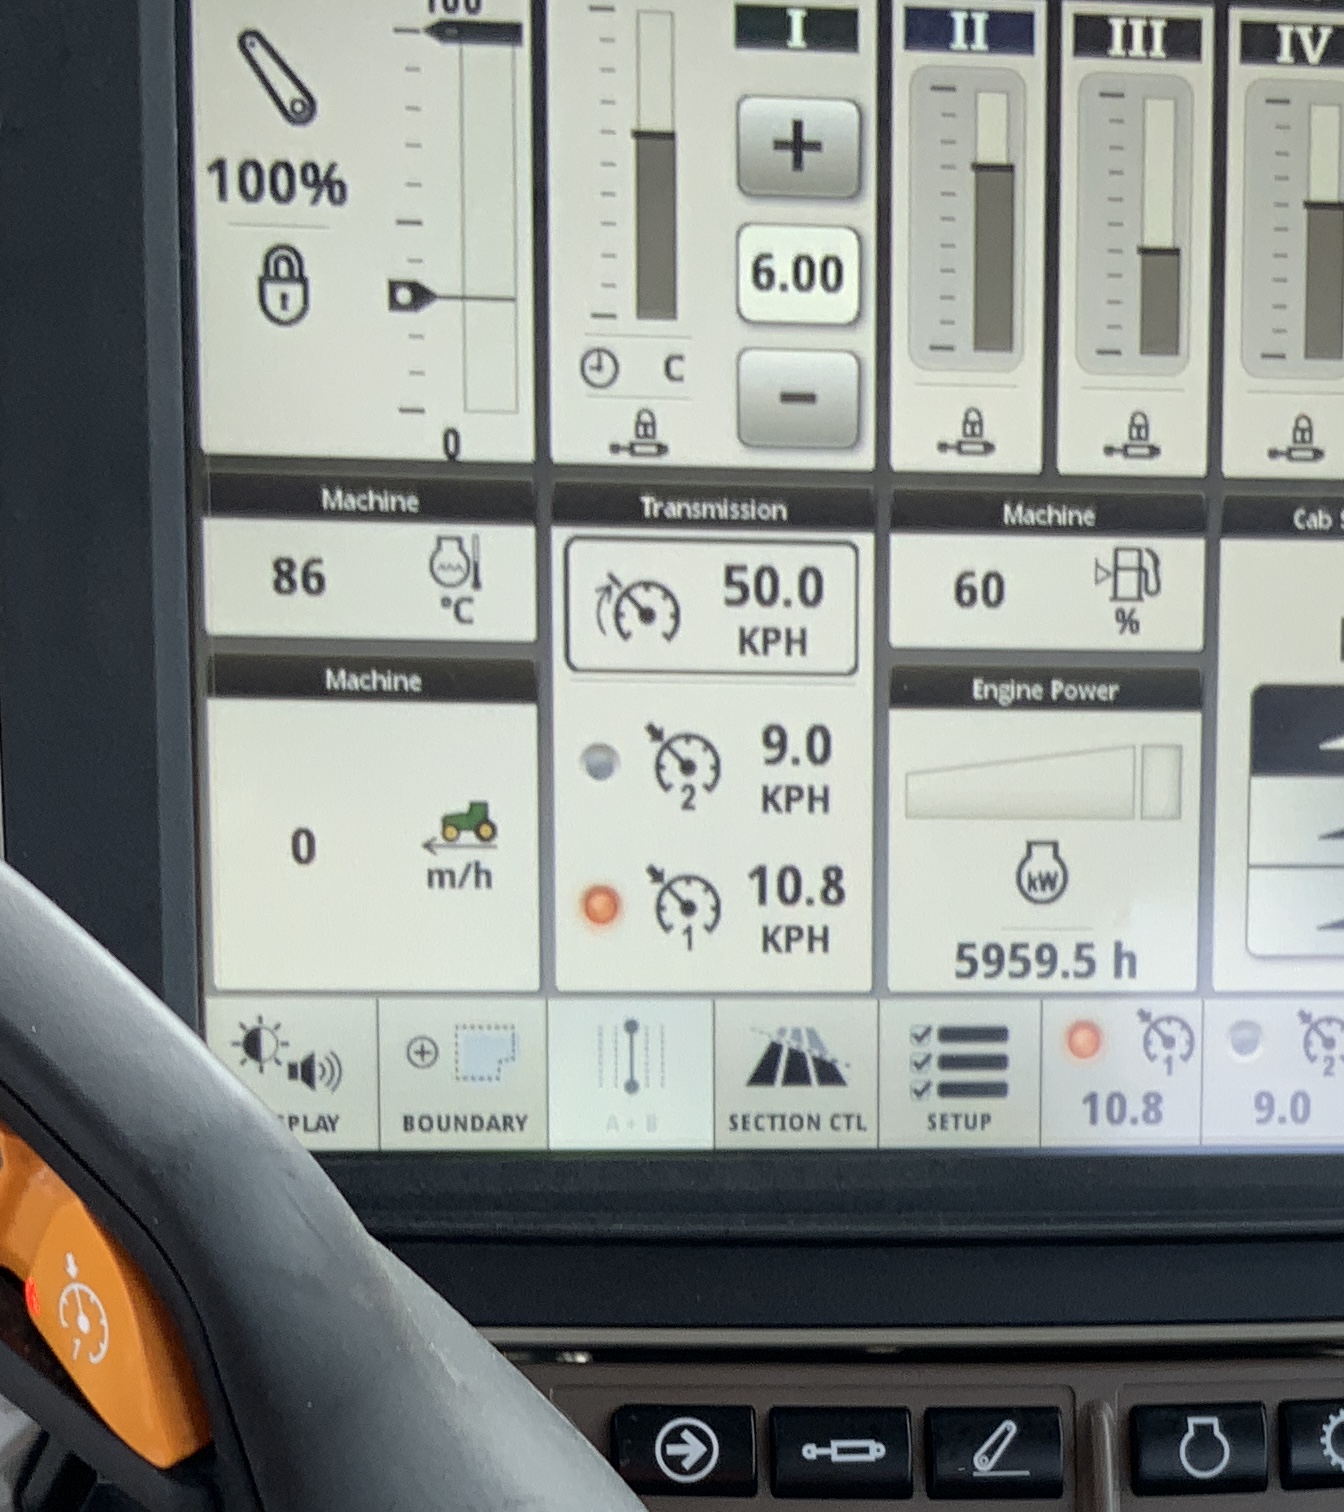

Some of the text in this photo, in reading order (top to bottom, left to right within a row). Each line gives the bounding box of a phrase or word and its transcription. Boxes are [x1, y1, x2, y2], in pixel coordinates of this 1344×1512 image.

[949, 12, 989, 52] II
[1107, 18, 1167, 59] III
[1276, 26, 1333, 64] IV
[207, 158, 346, 205] 100%
[751, 254, 844, 293] 6.00
[663, 354, 685, 382] C
[443, 427, 460, 463] 0
[321, 488, 419, 515] Machine
[639, 496, 787, 523] Transmission
[1002, 504, 1096, 528] Machine
[1293, 509, 1333, 531] Cab
[271, 556, 326, 597] 86
[722, 563, 824, 608] 50.0
[955, 569, 1005, 608] 60
[737, 627, 808, 657] KPH
[324, 668, 423, 693] Machine
[971, 679, 1120, 706] Engine Power
[760, 724, 832, 766] 9.0
[680, 785, 697, 811] 2
[760, 785, 831, 815] KPH
[290, 826, 316, 864] 0
[426, 862, 493, 891] m/h
[746, 864, 846, 907] 10.8
[682, 925, 694, 951] 1
[760, 925, 831, 954] KPH
[954, 940, 1138, 979] 5959.5 h
[926, 1112, 992, 1131] SETUP
[1082, 1091, 1163, 1126] 10.8
[1253, 1090, 1311, 1124] 9.0
[277, 1114, 340, 1133] PLAY
[403, 1113, 528, 1133] BOUNDARY
[728, 1113, 867, 1132] SECTION CTL
